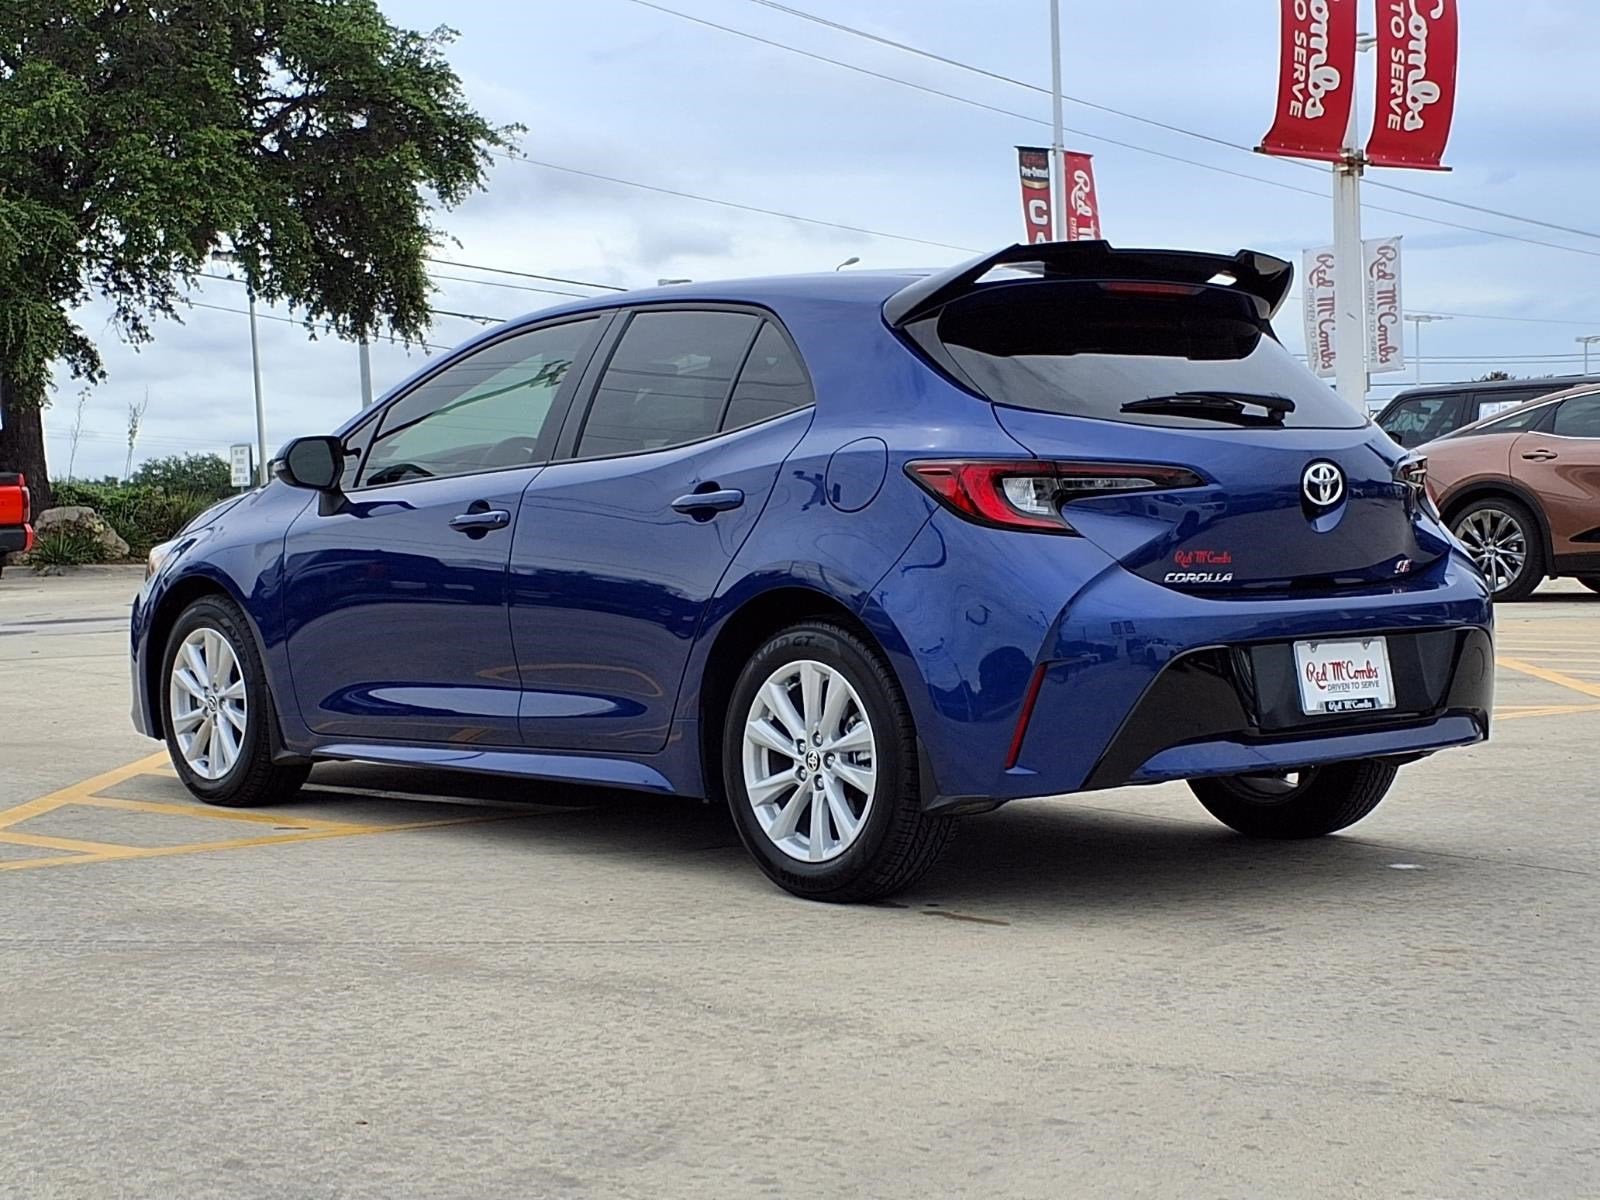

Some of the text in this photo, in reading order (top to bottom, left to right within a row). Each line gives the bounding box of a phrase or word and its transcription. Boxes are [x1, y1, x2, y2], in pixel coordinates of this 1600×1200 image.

[1289, 30, 1307, 118] SERVE
[1387, 3, 1405, 131] TO SERVE
[1071, 169, 1093, 217] Red
[1309, 253, 1335, 289] Red
[1308, 287, 1316, 322] DRIVEN
[1367, 281, 1378, 363] DRIVEN TO SERVE
[1369, 245, 1399, 364] Red McCombs
[1308, 325, 1317, 339] TO
[1174, 550, 1194, 568] Red
[1164, 572, 1234, 584] COROLLA
[1306, 660, 1379, 690] Red McCombs
[1328, 680, 1379, 692] DRIVEN TO SERVE
